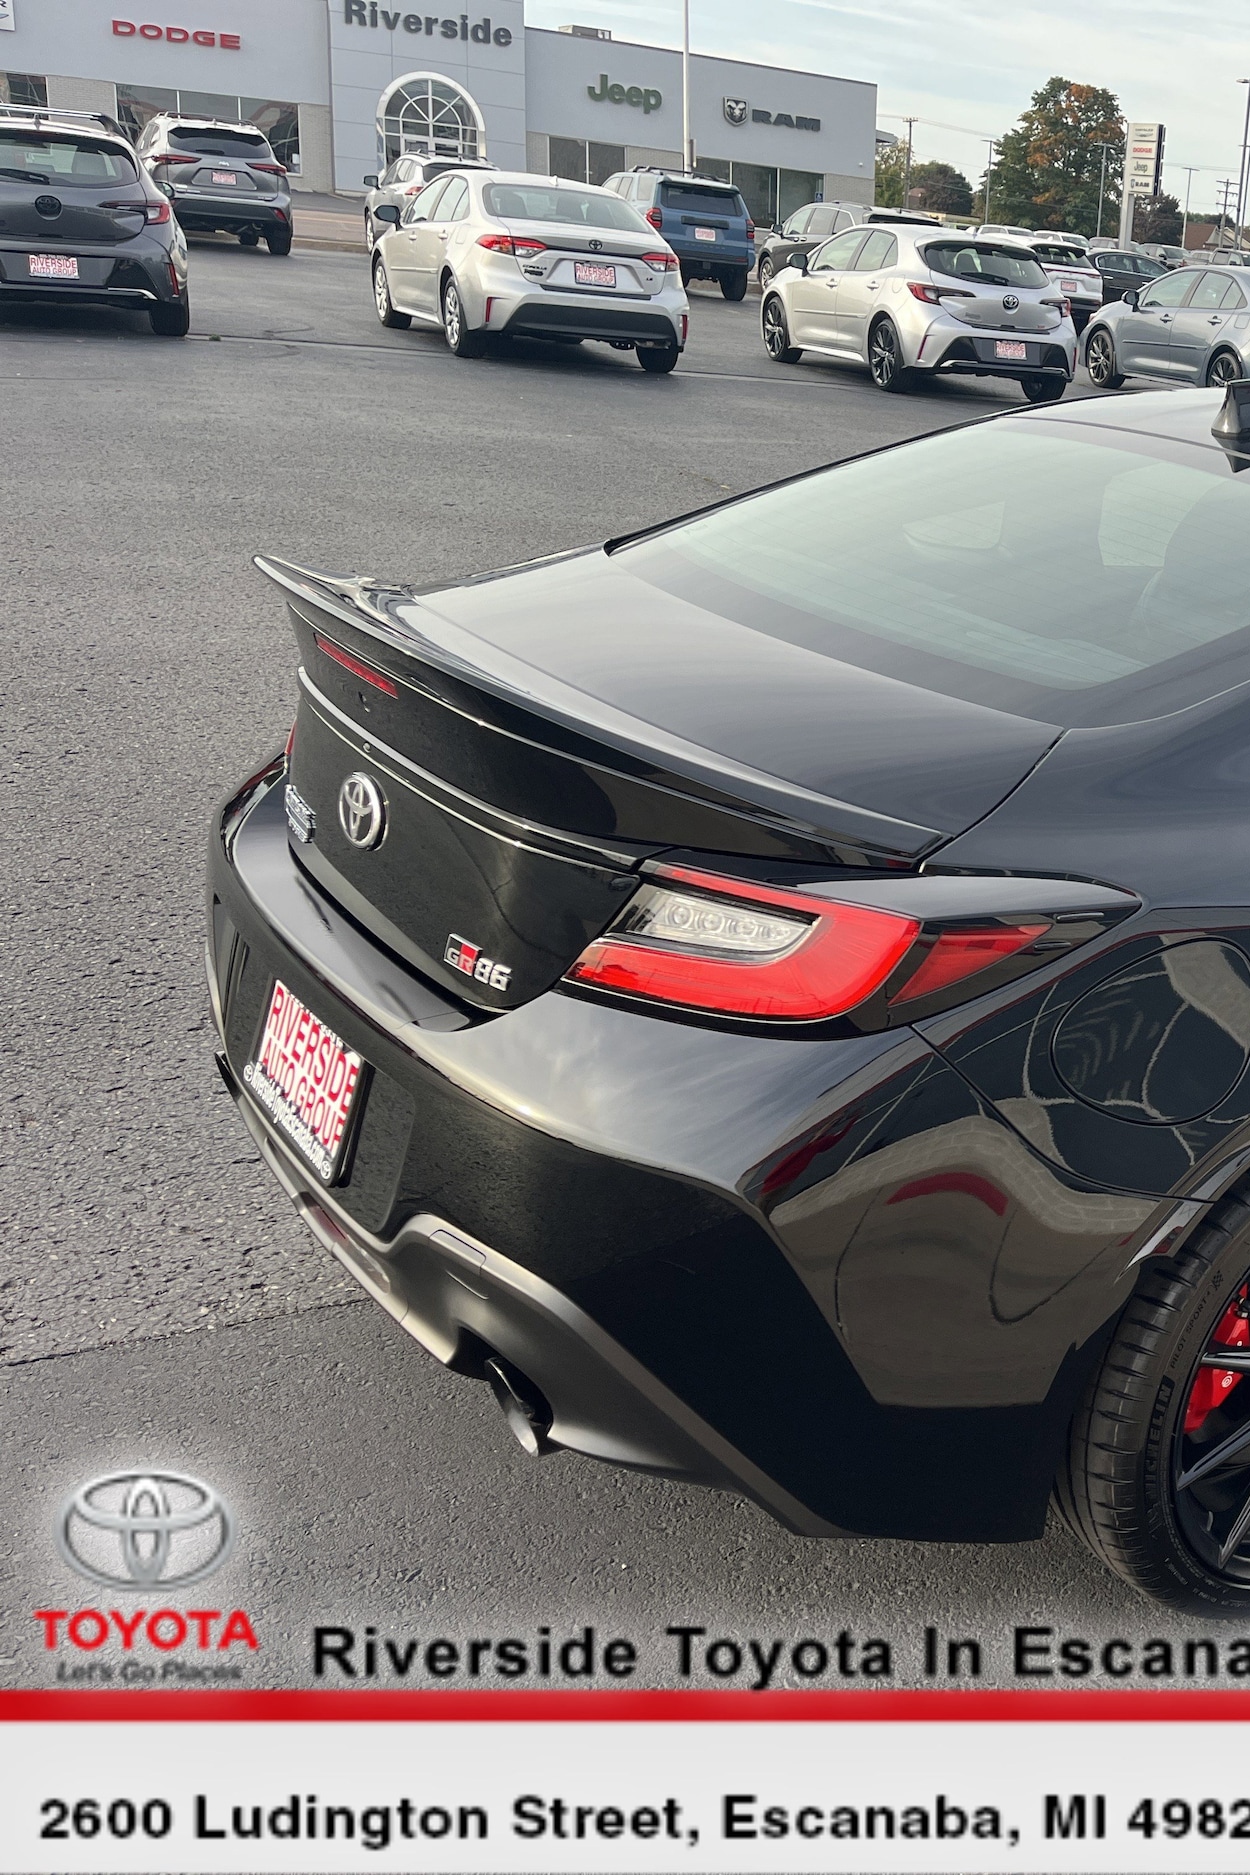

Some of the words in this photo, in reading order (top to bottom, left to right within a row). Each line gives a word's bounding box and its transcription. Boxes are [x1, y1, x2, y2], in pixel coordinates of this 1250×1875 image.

[111, 19, 241, 50] DODGE
[344, 0, 513, 47] Riverside
[587, 74, 663, 114] Jeep
[751, 109, 821, 132] RAM
[1133, 161, 1148, 173] Jeep
[30, 257, 77, 269] RIVERSIDE
[53, 267, 77, 276] GROUP
[576, 265, 615, 277] RIVERSIDE
[268, 984, 360, 1115] RIVERSIDE
[261, 1038, 296, 1101] AUTO
[298, 1075, 346, 1154] GROUP
[1170, 1336, 1187, 1370] PILOT
[1184, 1299, 1209, 1336] SPORT
[1144, 1378, 1175, 1500] MICHELIN
